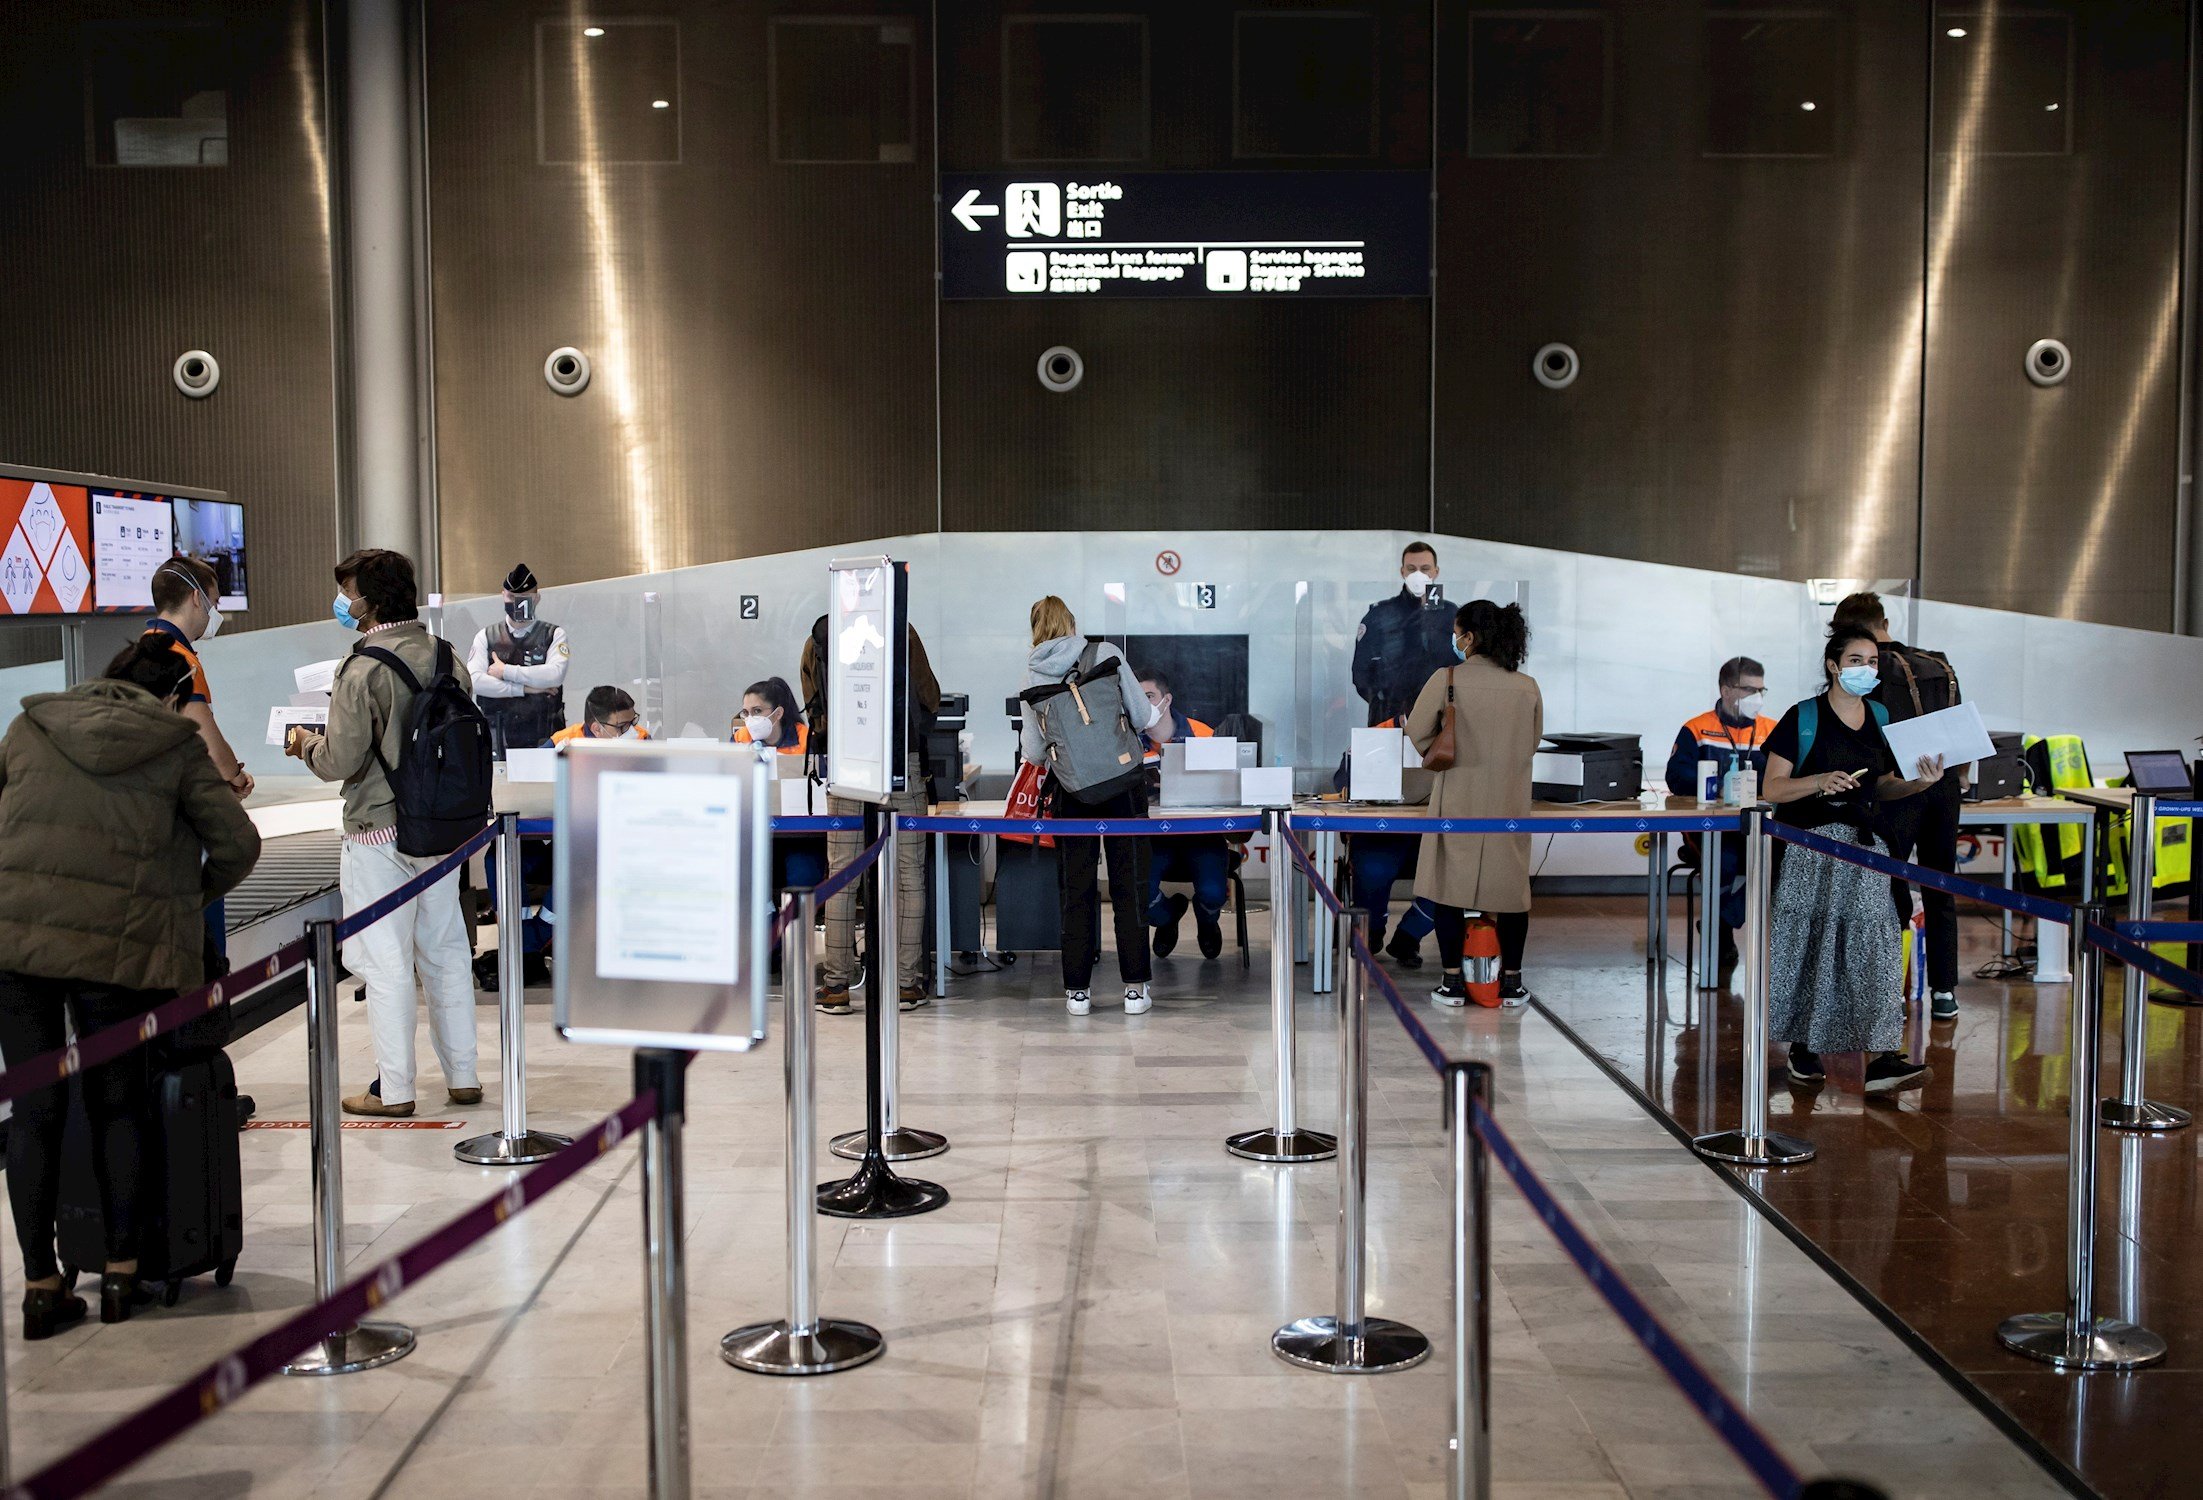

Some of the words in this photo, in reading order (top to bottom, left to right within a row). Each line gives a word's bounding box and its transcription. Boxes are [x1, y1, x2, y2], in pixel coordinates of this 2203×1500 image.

[1066, 181, 1123, 200] Sortie
[1066, 200, 1105, 219] Exit
[1066, 220, 1102, 239] 出口
[1050, 251, 1109, 266] Bagages
[1111, 250, 1144, 264] hors
[1145, 250, 1195, 264] format
[1250, 250, 1302, 264] Service
[1122, 265, 1184, 281] Baggage
[1250, 264, 1311, 280] Baggage
[1313, 264, 1366, 278] Service
[1200, 588, 1213, 608] 3
[1428, 586, 1440, 606] 4
[518, 599, 529, 619] 1
[743, 598, 757, 618] 2
[853, 683, 871, 693] COUNTER
